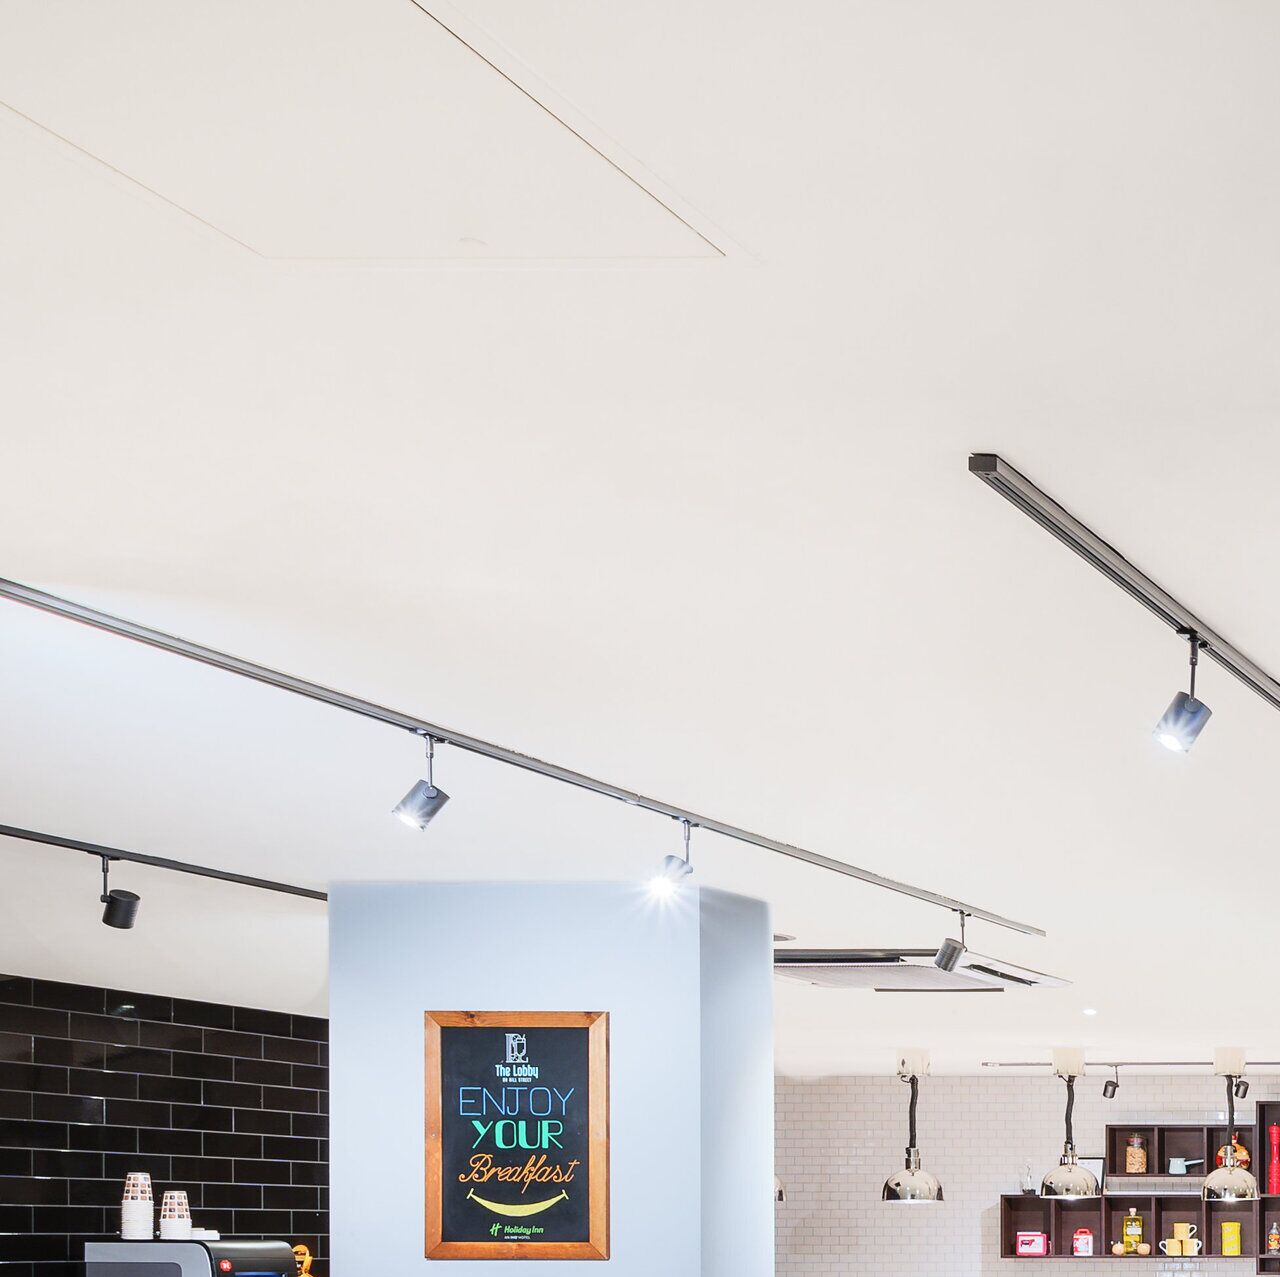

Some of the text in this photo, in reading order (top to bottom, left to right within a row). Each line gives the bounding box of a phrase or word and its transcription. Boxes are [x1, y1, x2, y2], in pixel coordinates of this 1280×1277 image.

[495, 1064, 539, 1079] The Lobby
[459, 1086, 575, 1116] ENJOY
[471, 1119, 563, 1149] YOUR
[458, 1153, 580, 1194] Breakfast
[504, 1225, 544, 1235] Holiday Inn
